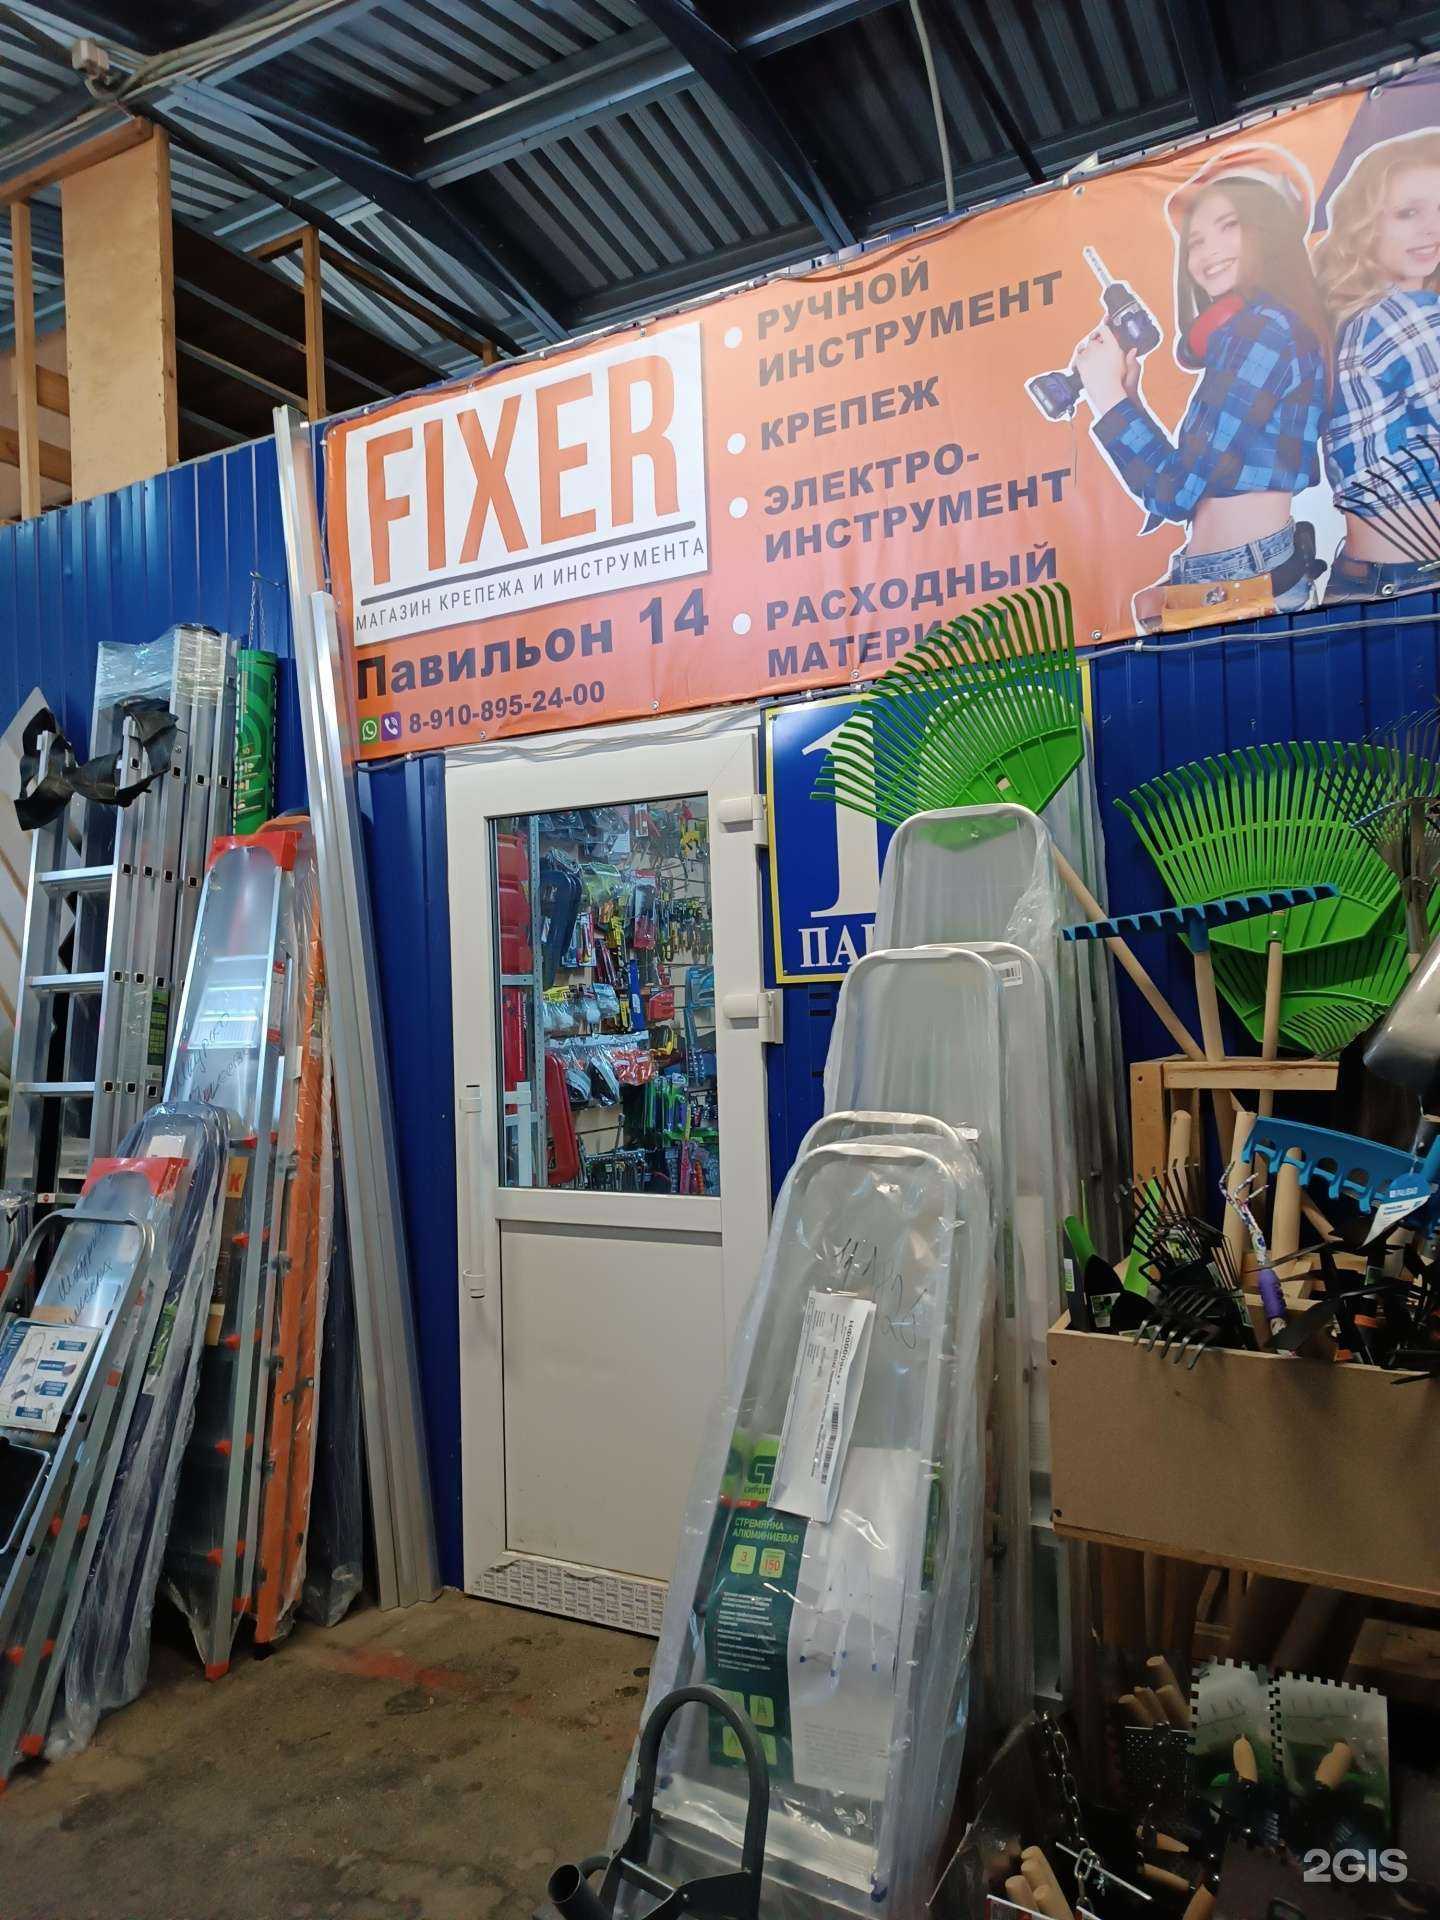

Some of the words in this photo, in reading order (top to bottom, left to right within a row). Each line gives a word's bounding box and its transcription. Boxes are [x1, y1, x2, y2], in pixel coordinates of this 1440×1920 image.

[757, 254, 930, 341] РУЧНОЙ
[758, 270, 1063, 387] ИНСТРУМЕНТ
[760, 375, 941, 451] КРЕПЕЖ
[366, 354, 680, 587] FIXER
[763, 442, 980, 517] ЭЛЕКТРО-
[764, 467, 1072, 564] ИНСТРУМЕНТ
[355, 598, 432, 632] МАГАЗИН
[438, 579, 525, 613] КРЕПЕЖА
[533, 573, 544, 592] И
[552, 535, 706, 586] ИНСТРУМЕНТА
[766, 541, 1058, 632] РАСХОДНЫЙ
[356, 619, 614, 701] Павильон
[638, 587, 710, 647] 14
[408, 680, 606, 735] 8-910-895-24-00
[732, 1527, 800, 1545] АЛЮМИНИЕВАЯ
[735, 1517, 785, 1531] СТРЕМЯНКА
